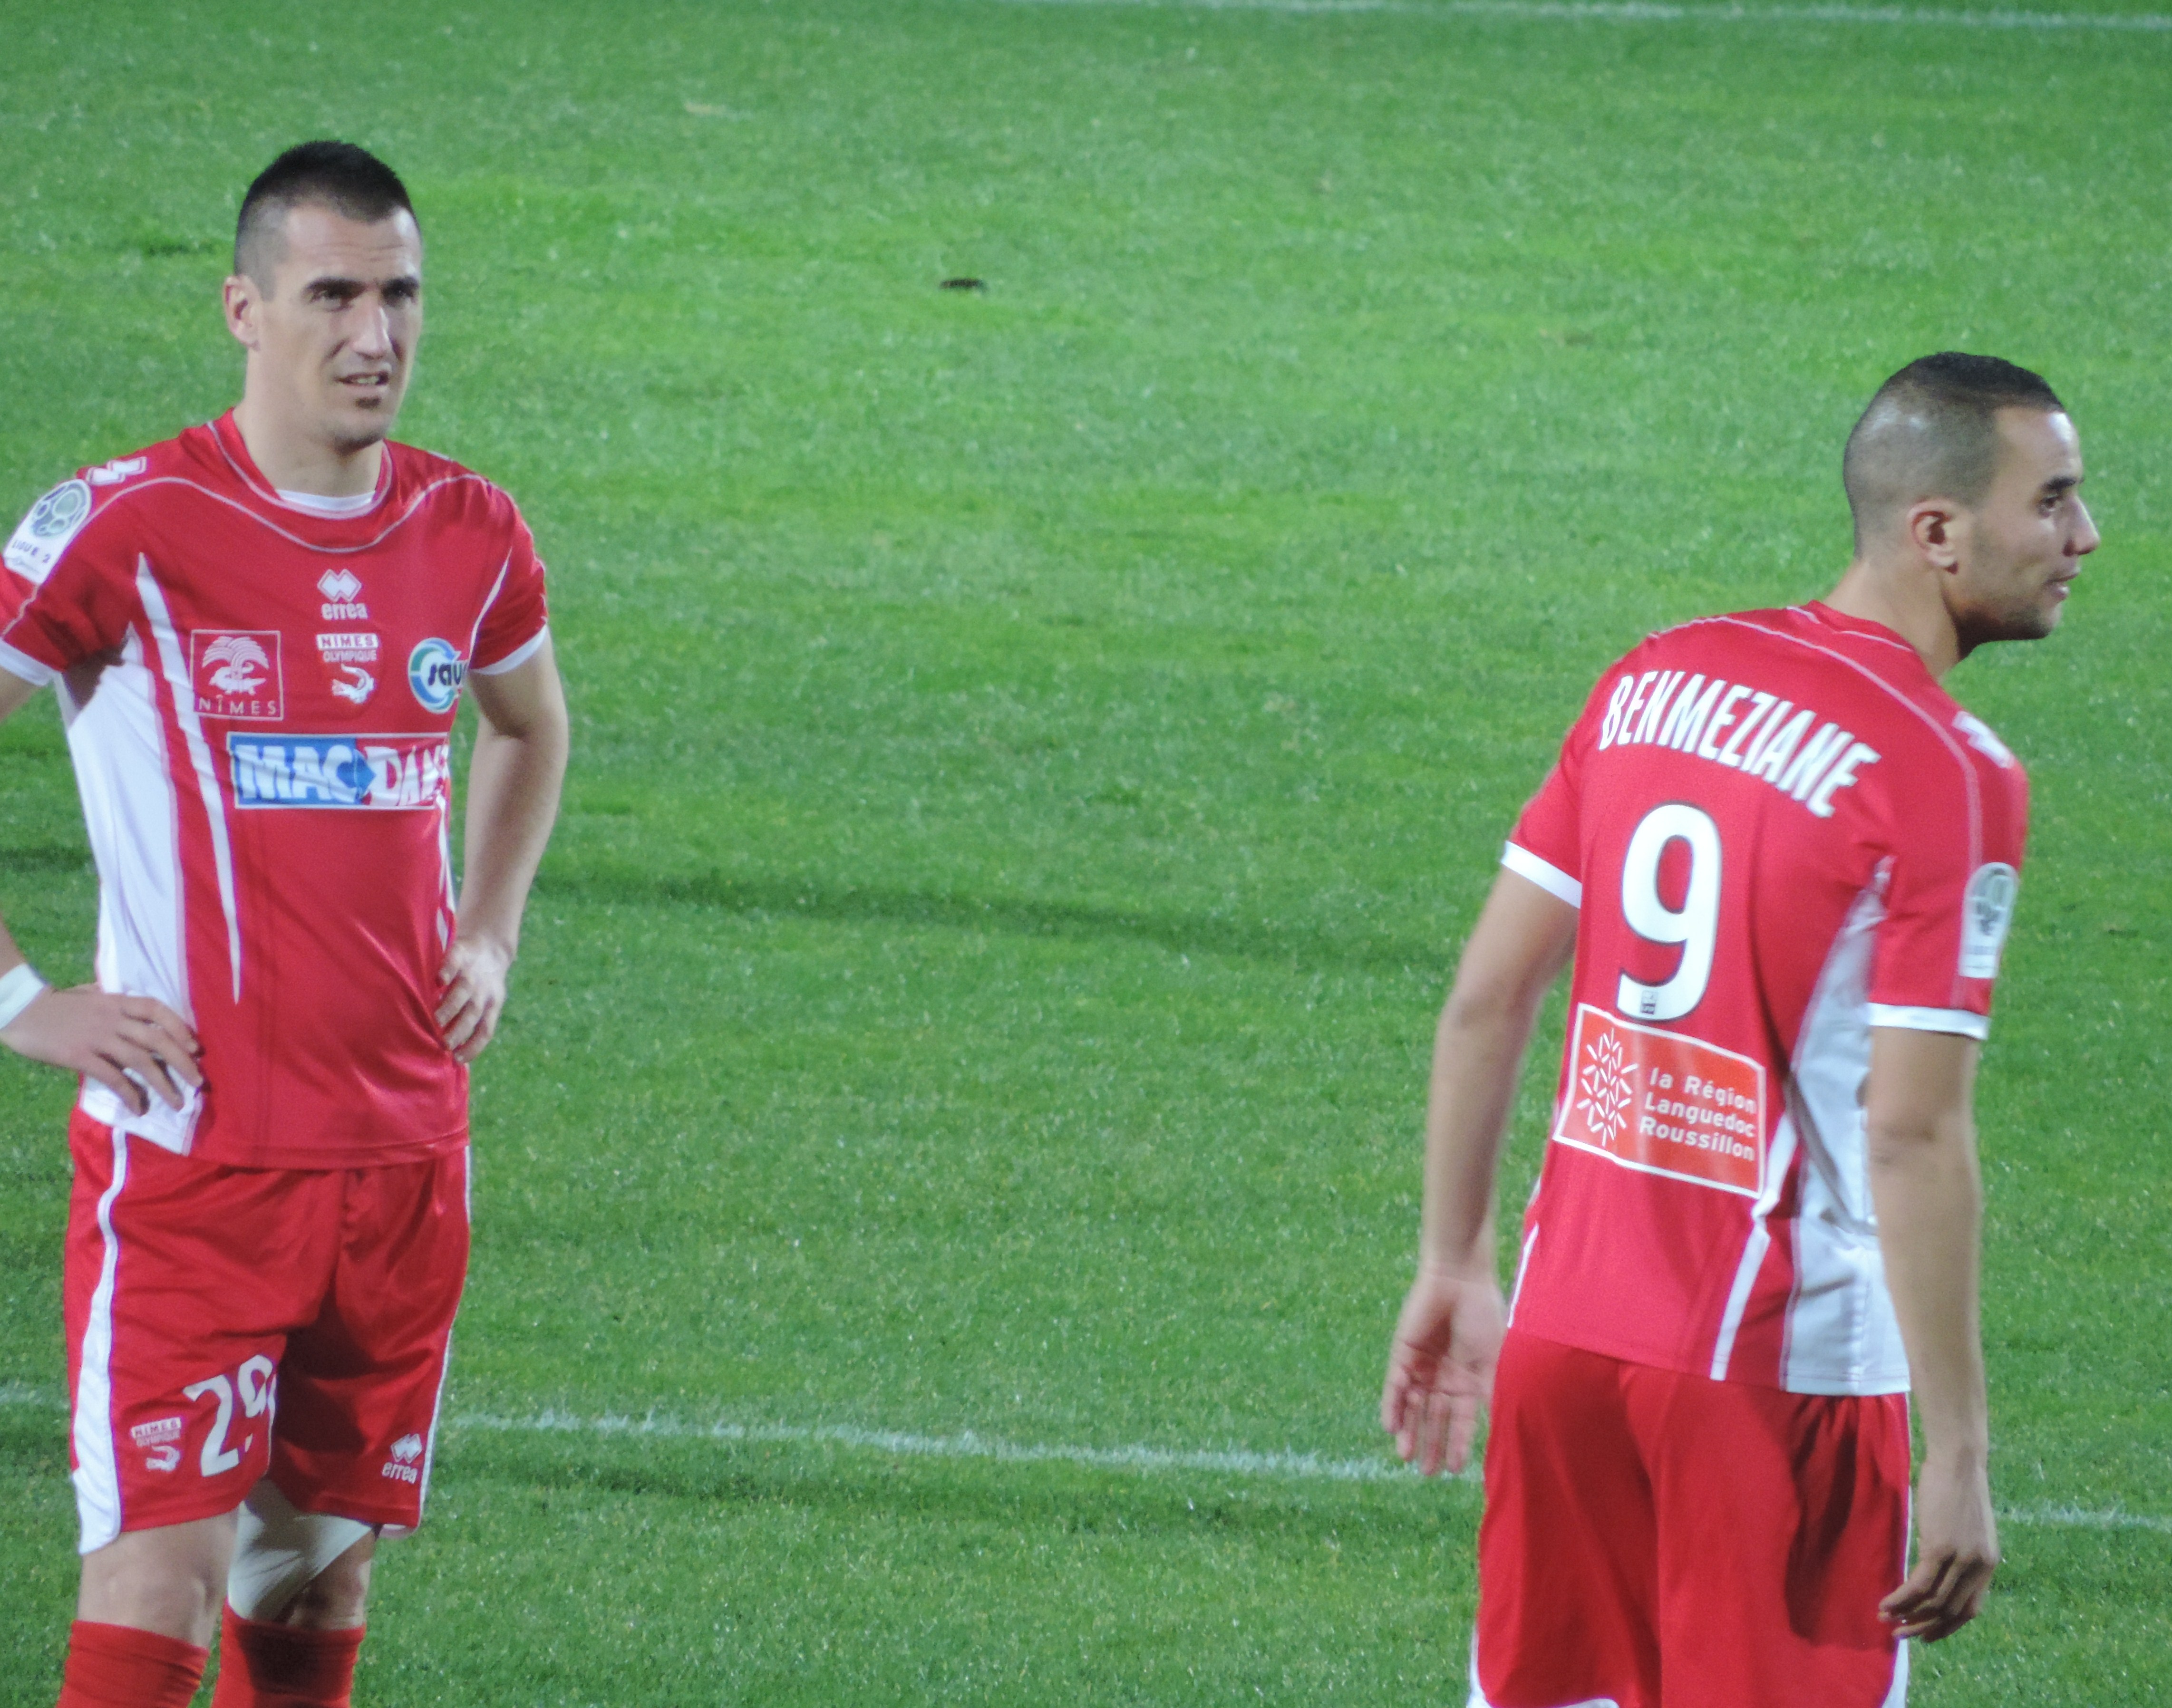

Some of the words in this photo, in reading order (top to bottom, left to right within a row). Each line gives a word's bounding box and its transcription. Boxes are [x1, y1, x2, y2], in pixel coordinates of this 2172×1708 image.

[321, 603, 368, 620] errea
[198, 695, 277, 716] NÎMES
[1599, 670, 1881, 818] BENMEZIANE
[1617, 803, 1722, 1022] 9
[1649, 1067, 1673, 1090] la
[1684, 1075, 1756, 1115] Région
[1645, 1091, 1755, 1138] Languedoc
[1639, 1116, 1755, 1161] Roussillon
[381, 1461, 418, 1484] errea
